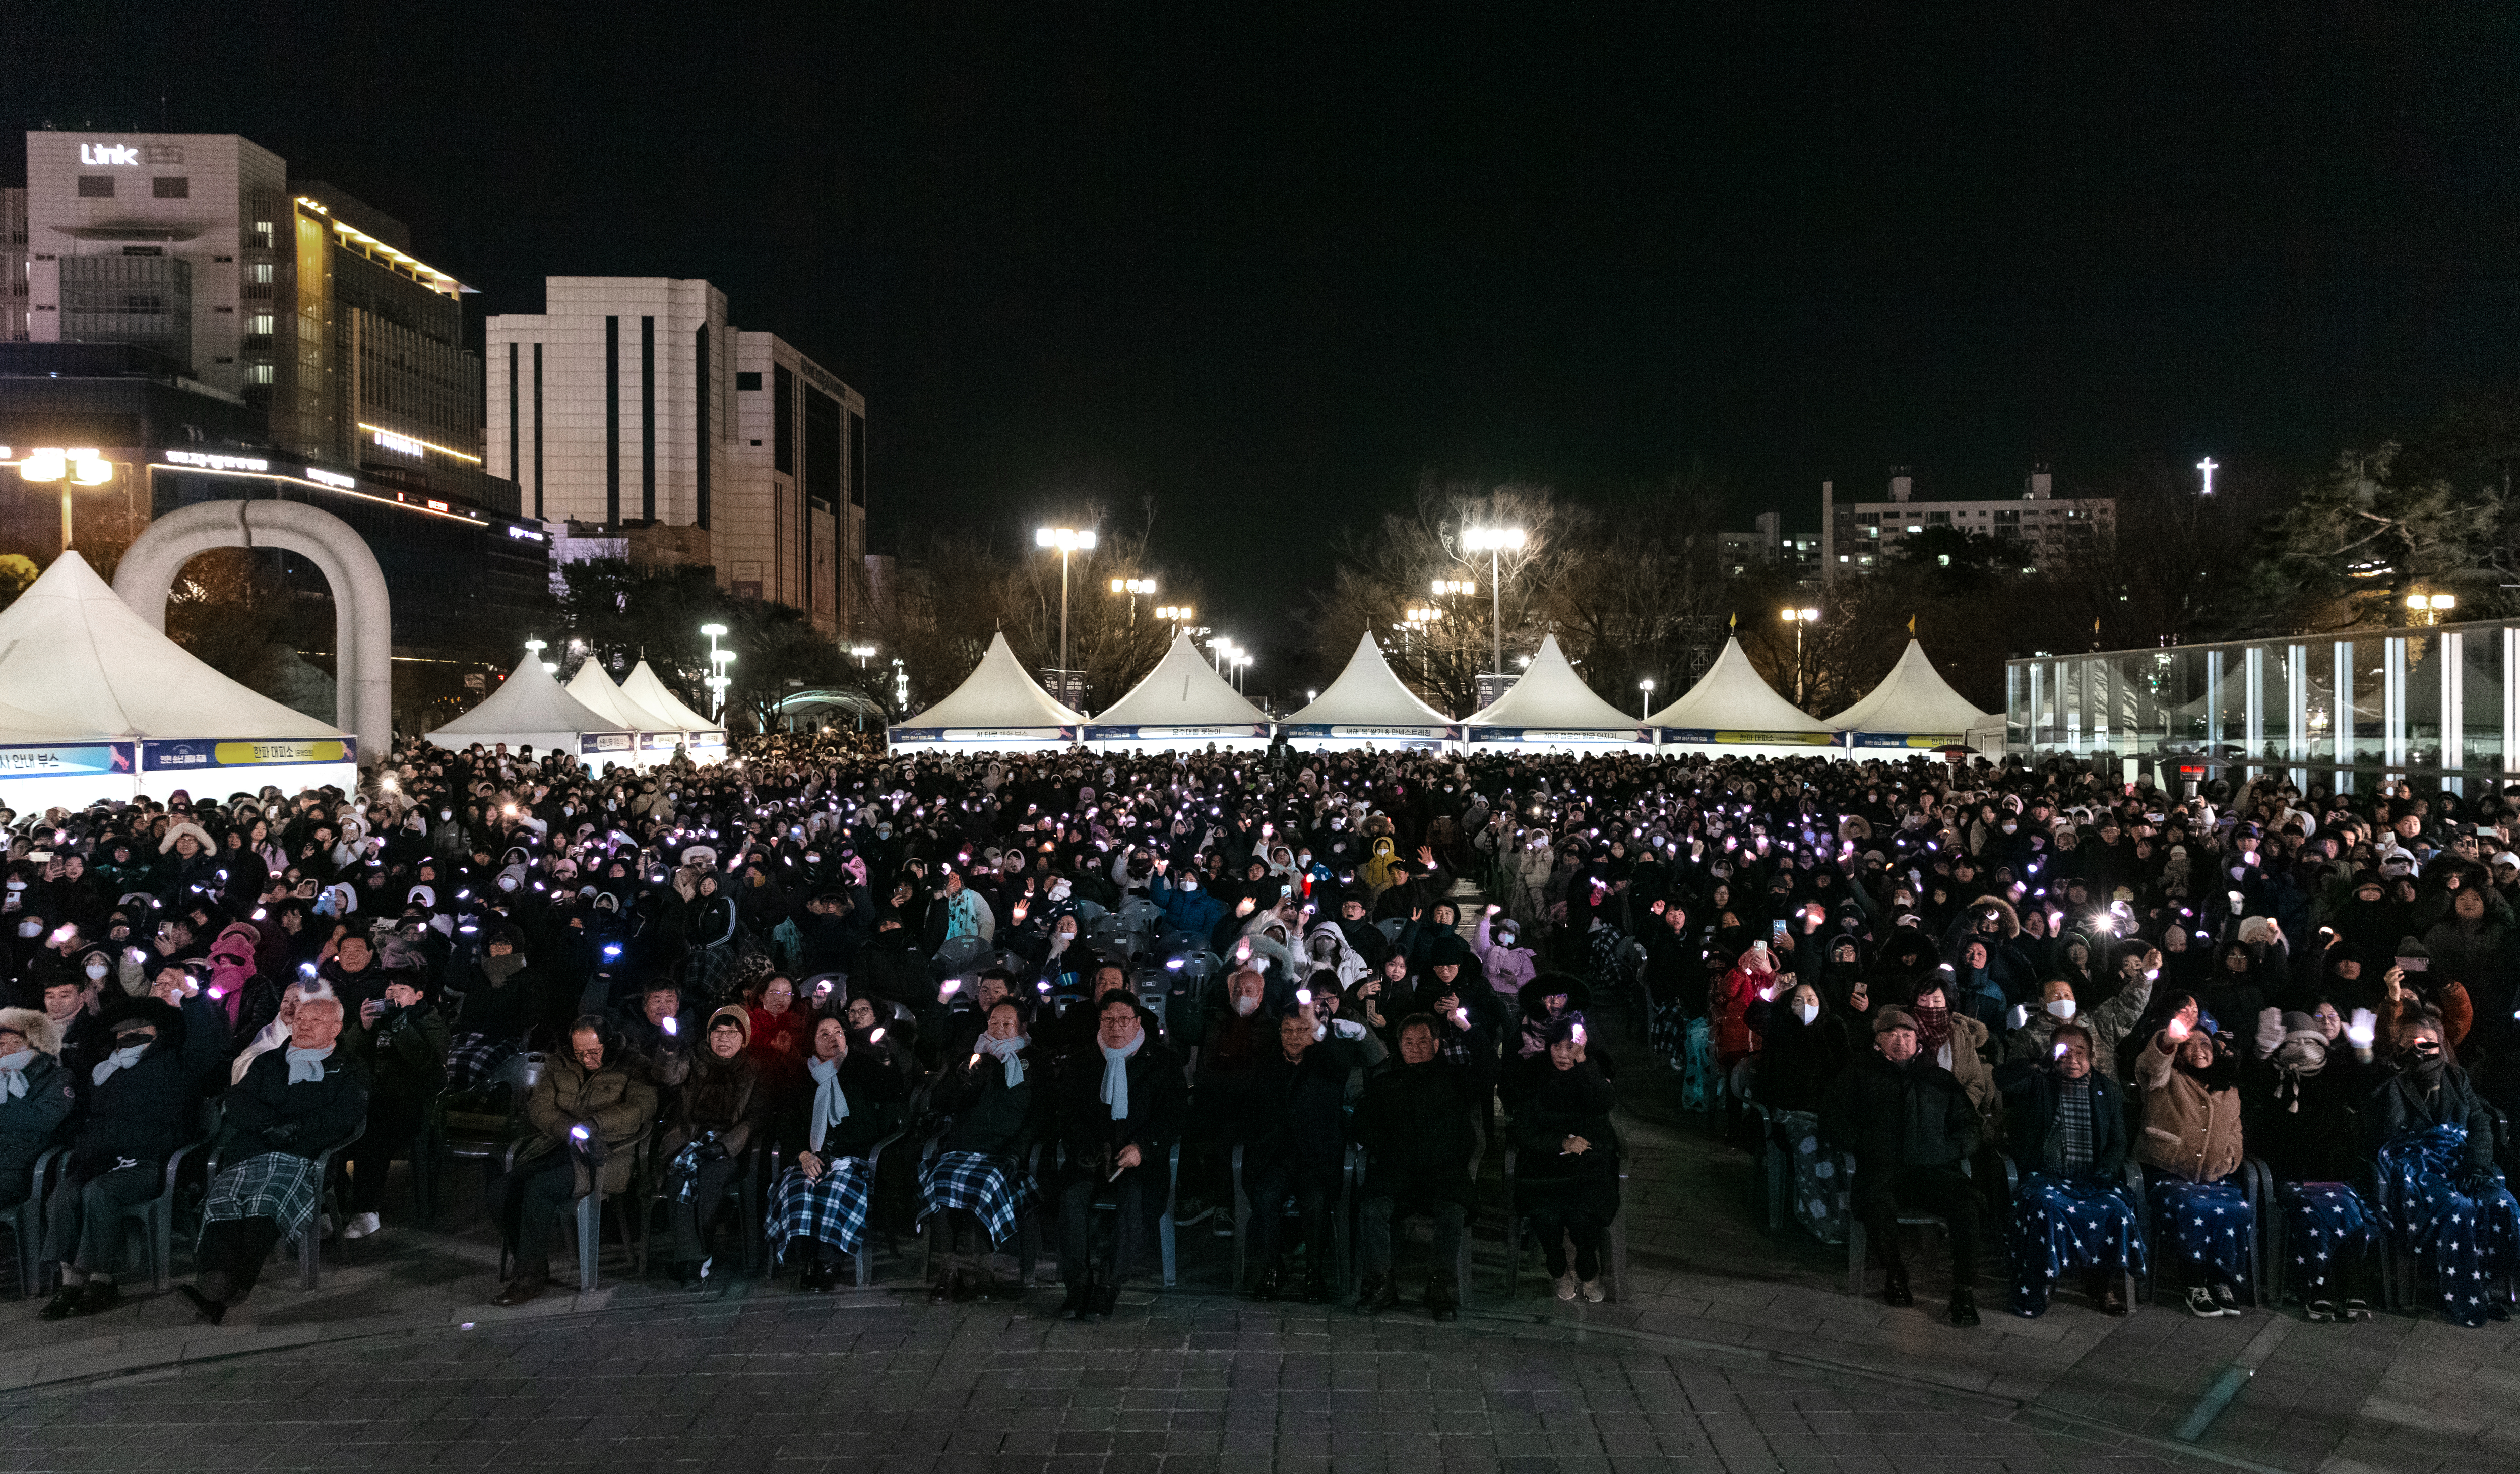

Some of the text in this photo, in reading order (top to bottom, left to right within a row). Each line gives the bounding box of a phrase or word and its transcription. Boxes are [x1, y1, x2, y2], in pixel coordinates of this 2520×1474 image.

[82, 143, 138, 165] Link
[254, 746, 270, 758] 한파
[272, 746, 293, 758] 대피소
[13, 754, 35, 769] 안내
[38, 753, 59, 768] 부스
[160, 755, 172, 764] 인천
[173, 755, 184, 764] 송년
